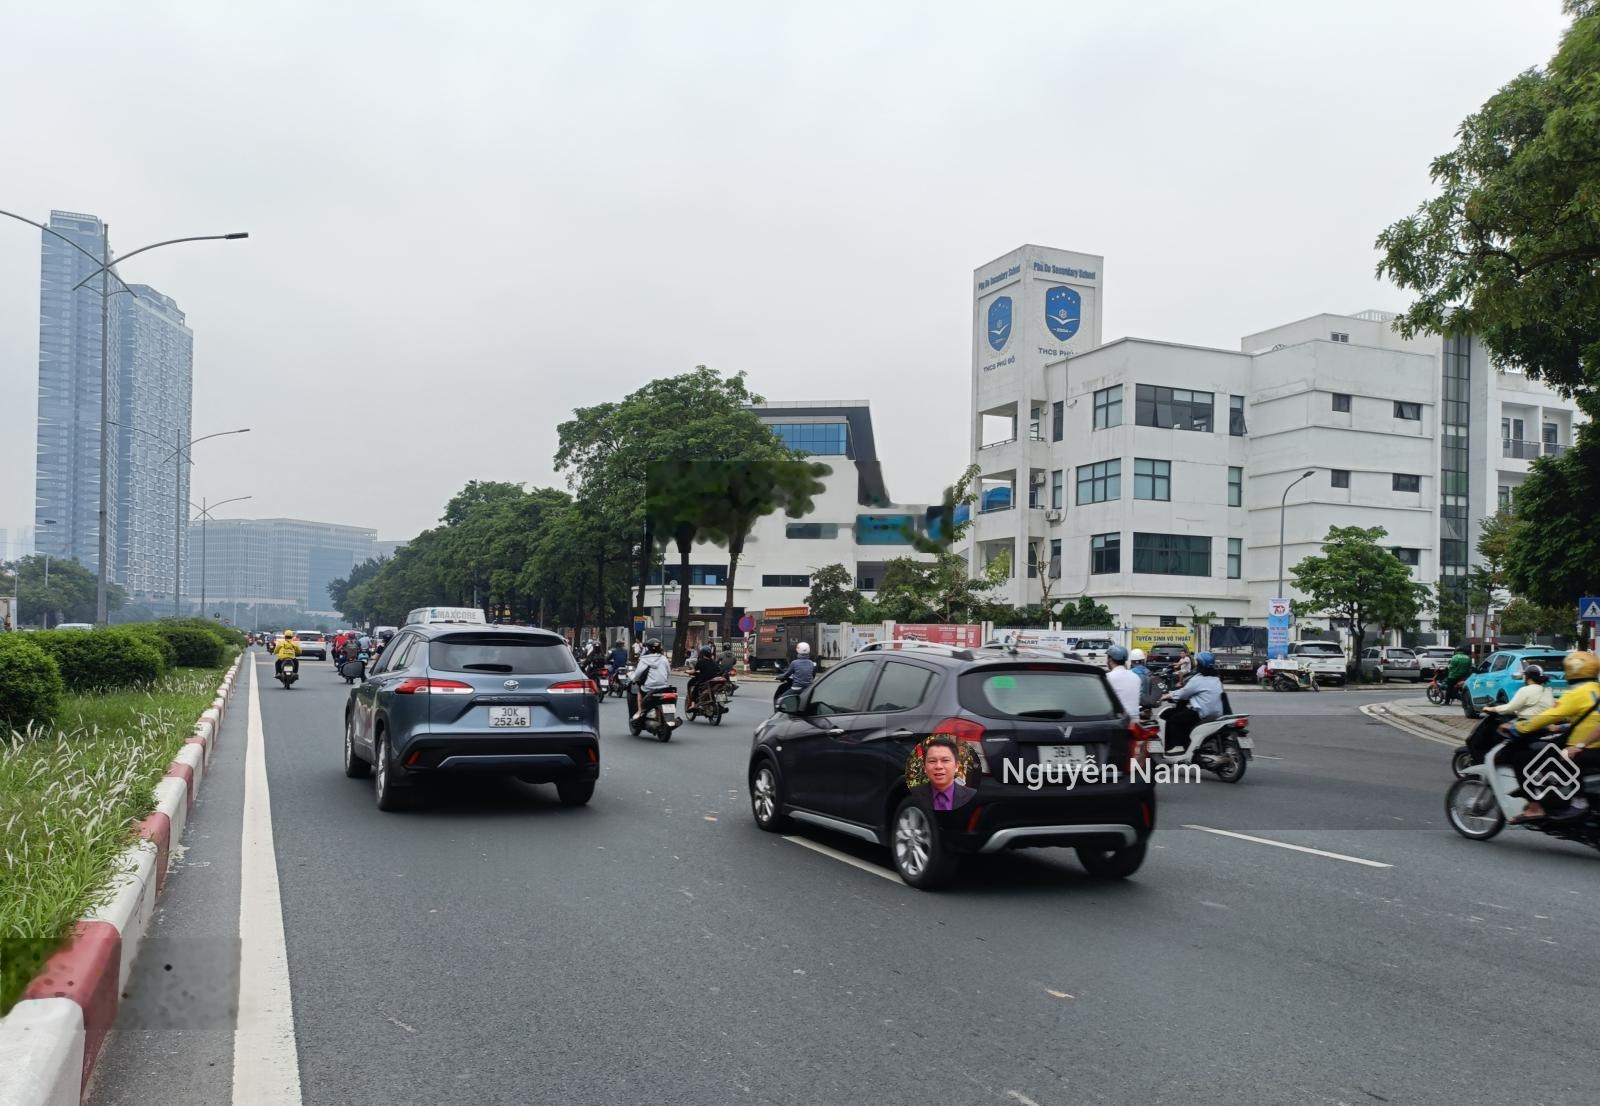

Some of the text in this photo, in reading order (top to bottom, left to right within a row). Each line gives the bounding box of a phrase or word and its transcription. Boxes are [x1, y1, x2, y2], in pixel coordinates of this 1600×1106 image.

[1079, 269, 1096, 280] School
[1038, 347, 1058, 356] THCS
[983, 363, 996, 373] THCS
[501, 707, 519, 717] 30K
[494, 717, 527, 727] 252.46
